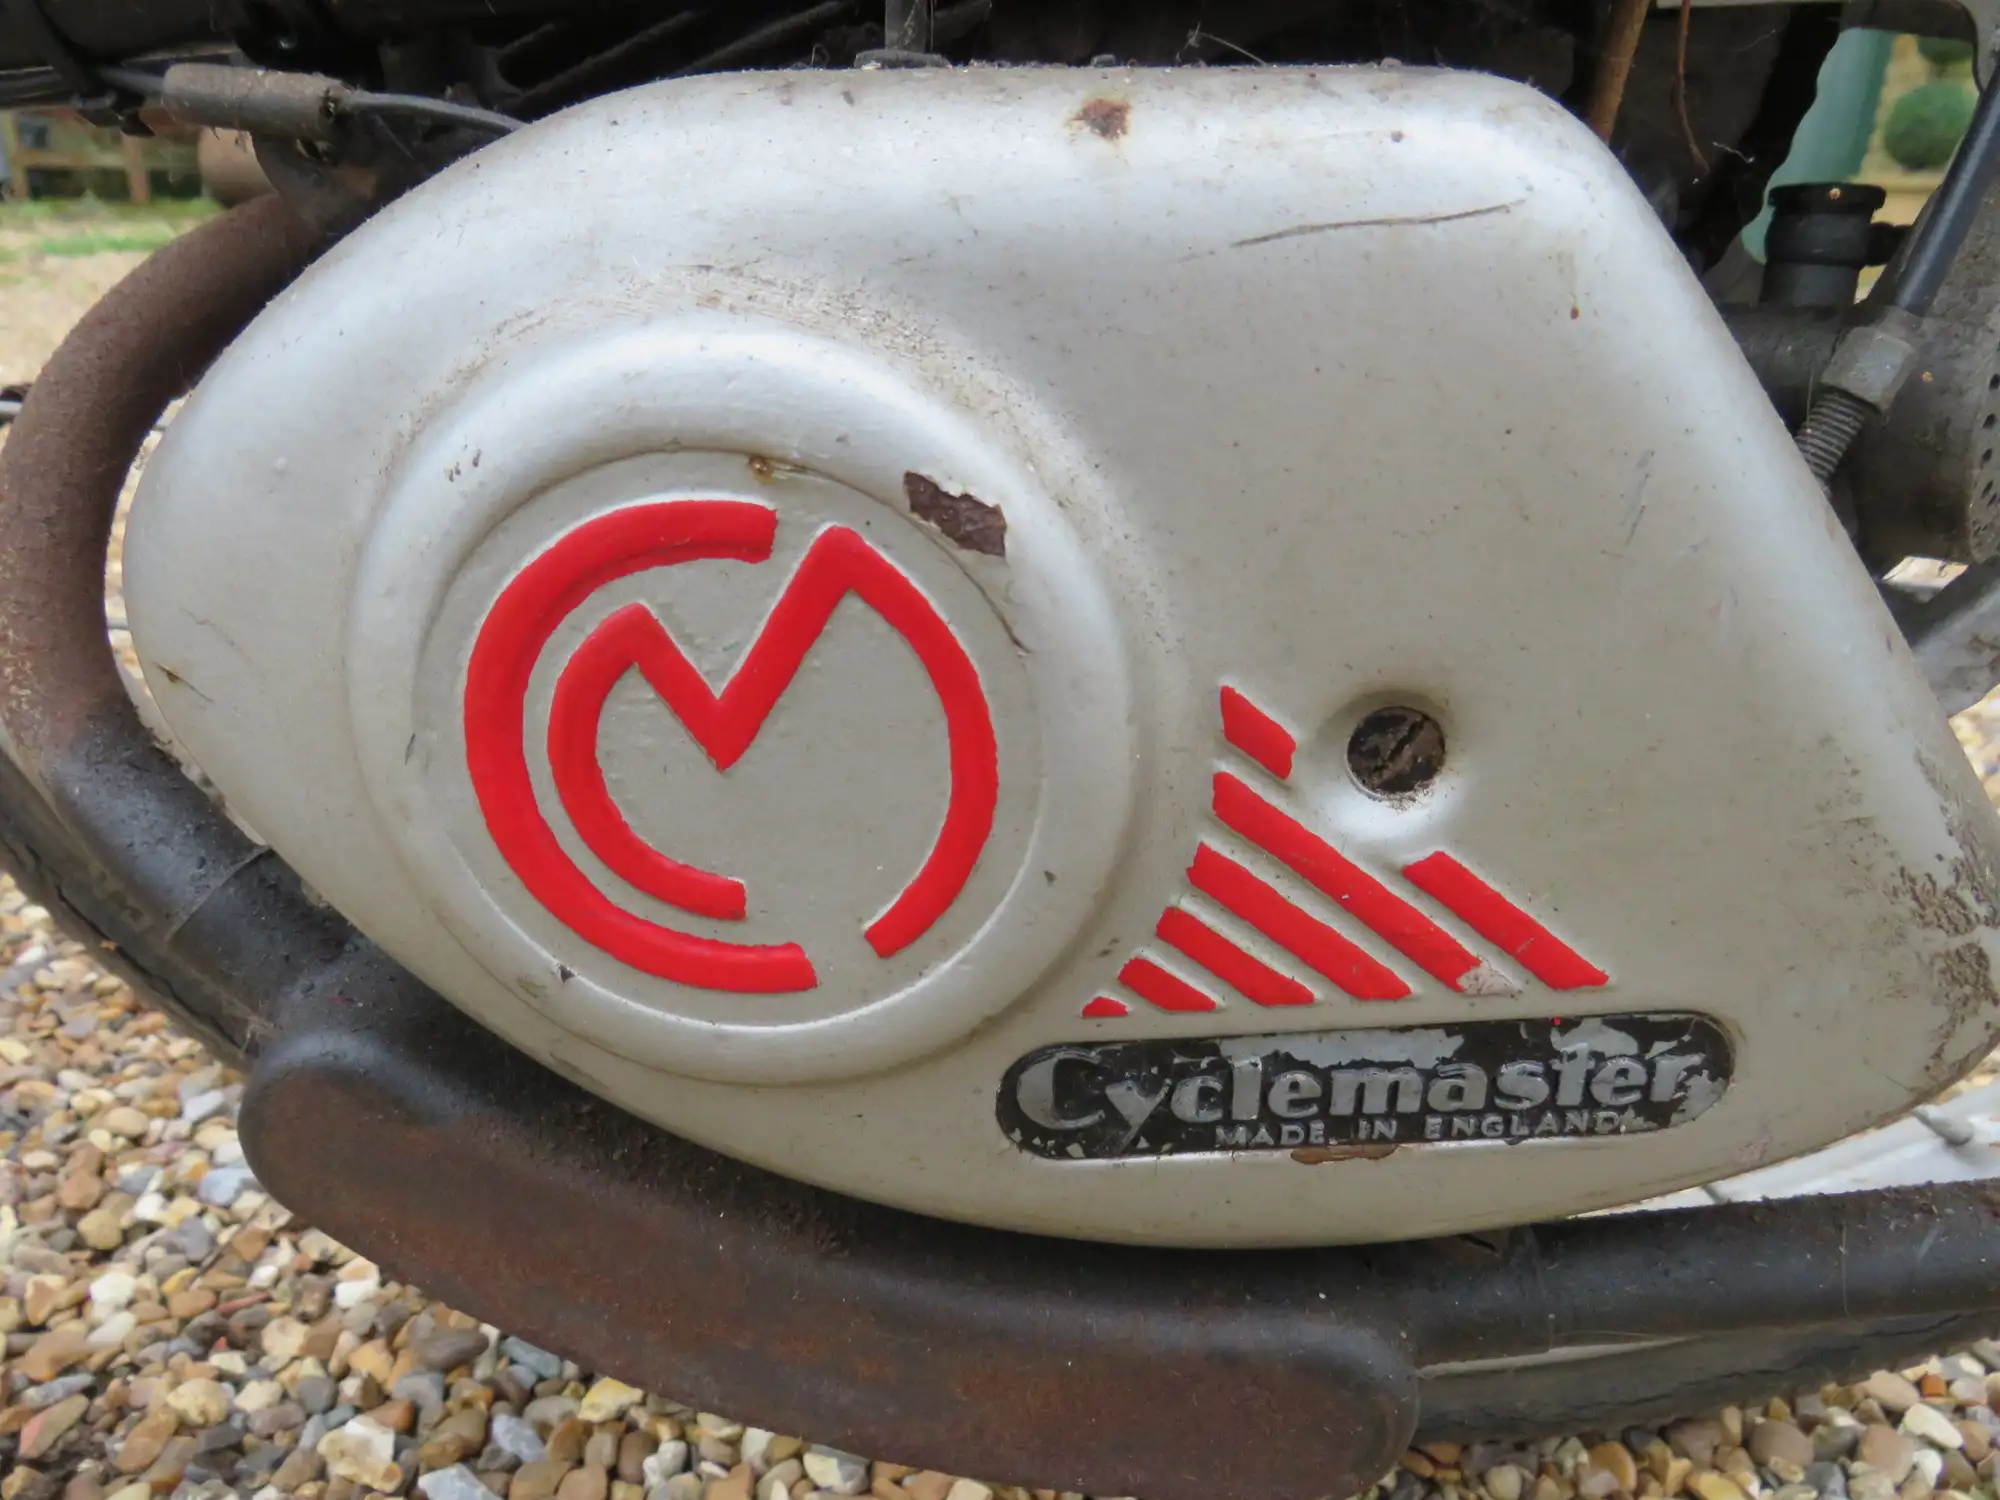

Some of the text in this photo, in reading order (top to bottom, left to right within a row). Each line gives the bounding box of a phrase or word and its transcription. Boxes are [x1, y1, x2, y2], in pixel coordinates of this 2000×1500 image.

[1016, 1043, 1706, 1150] Cyclemaster
[1215, 1110, 1620, 1147] MADE IN ENGLAND
